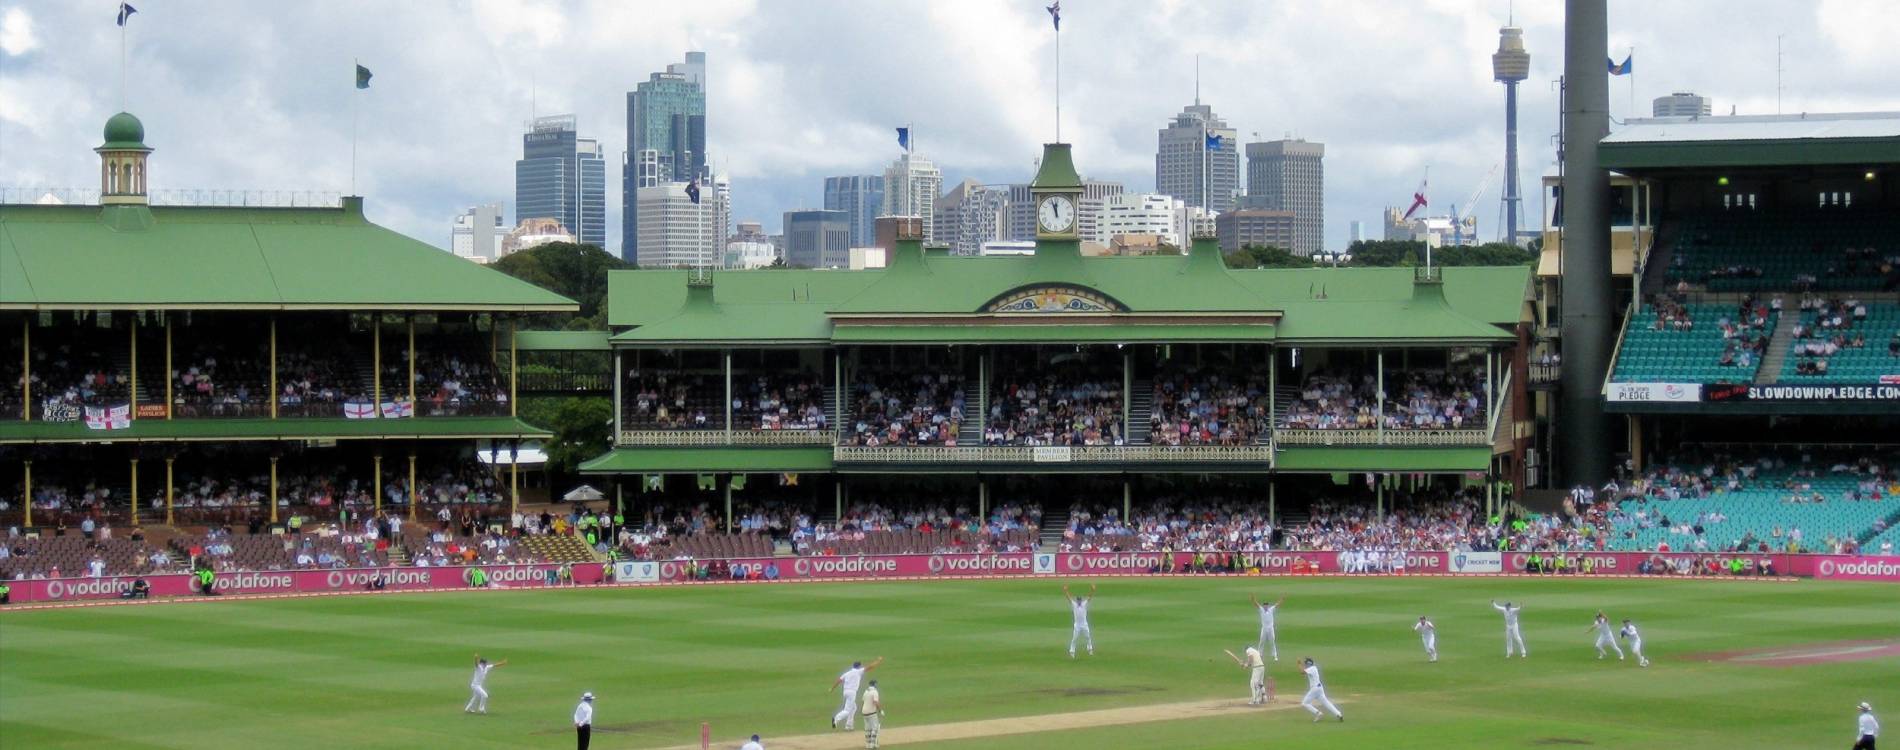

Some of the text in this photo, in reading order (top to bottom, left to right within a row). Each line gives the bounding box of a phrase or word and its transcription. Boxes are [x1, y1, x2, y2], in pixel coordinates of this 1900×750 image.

[1619, 391, 1650, 400] PLEDGE
[813, 556, 897, 572] vodafone
[1086, 553, 1159, 569] vodafon
